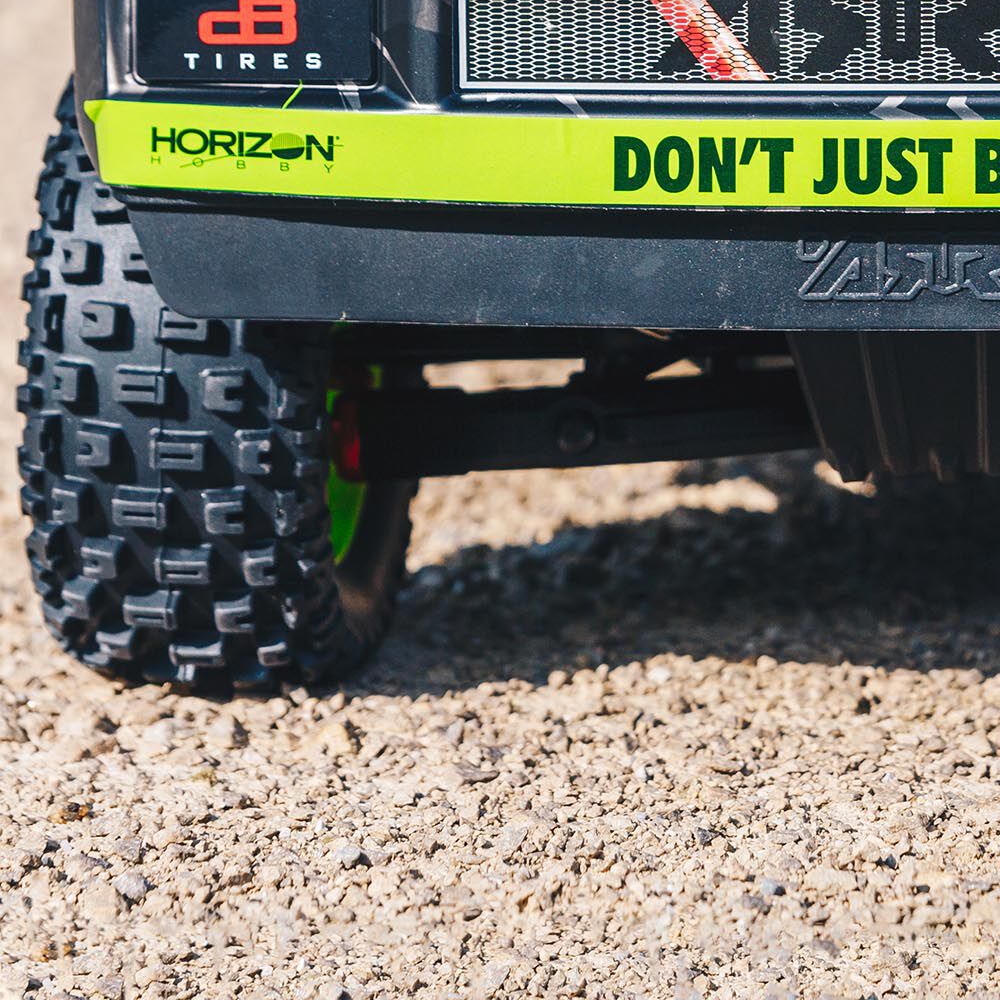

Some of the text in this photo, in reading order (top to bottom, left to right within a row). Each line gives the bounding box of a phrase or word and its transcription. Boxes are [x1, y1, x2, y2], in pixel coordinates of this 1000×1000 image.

[184, 53, 322, 70] TIRES
[151, 126, 335, 162] HORIZON
[151, 156, 334, 173] HOBBY
[613, 135, 794, 193] DON'T
[813, 137, 953, 194] JUST
